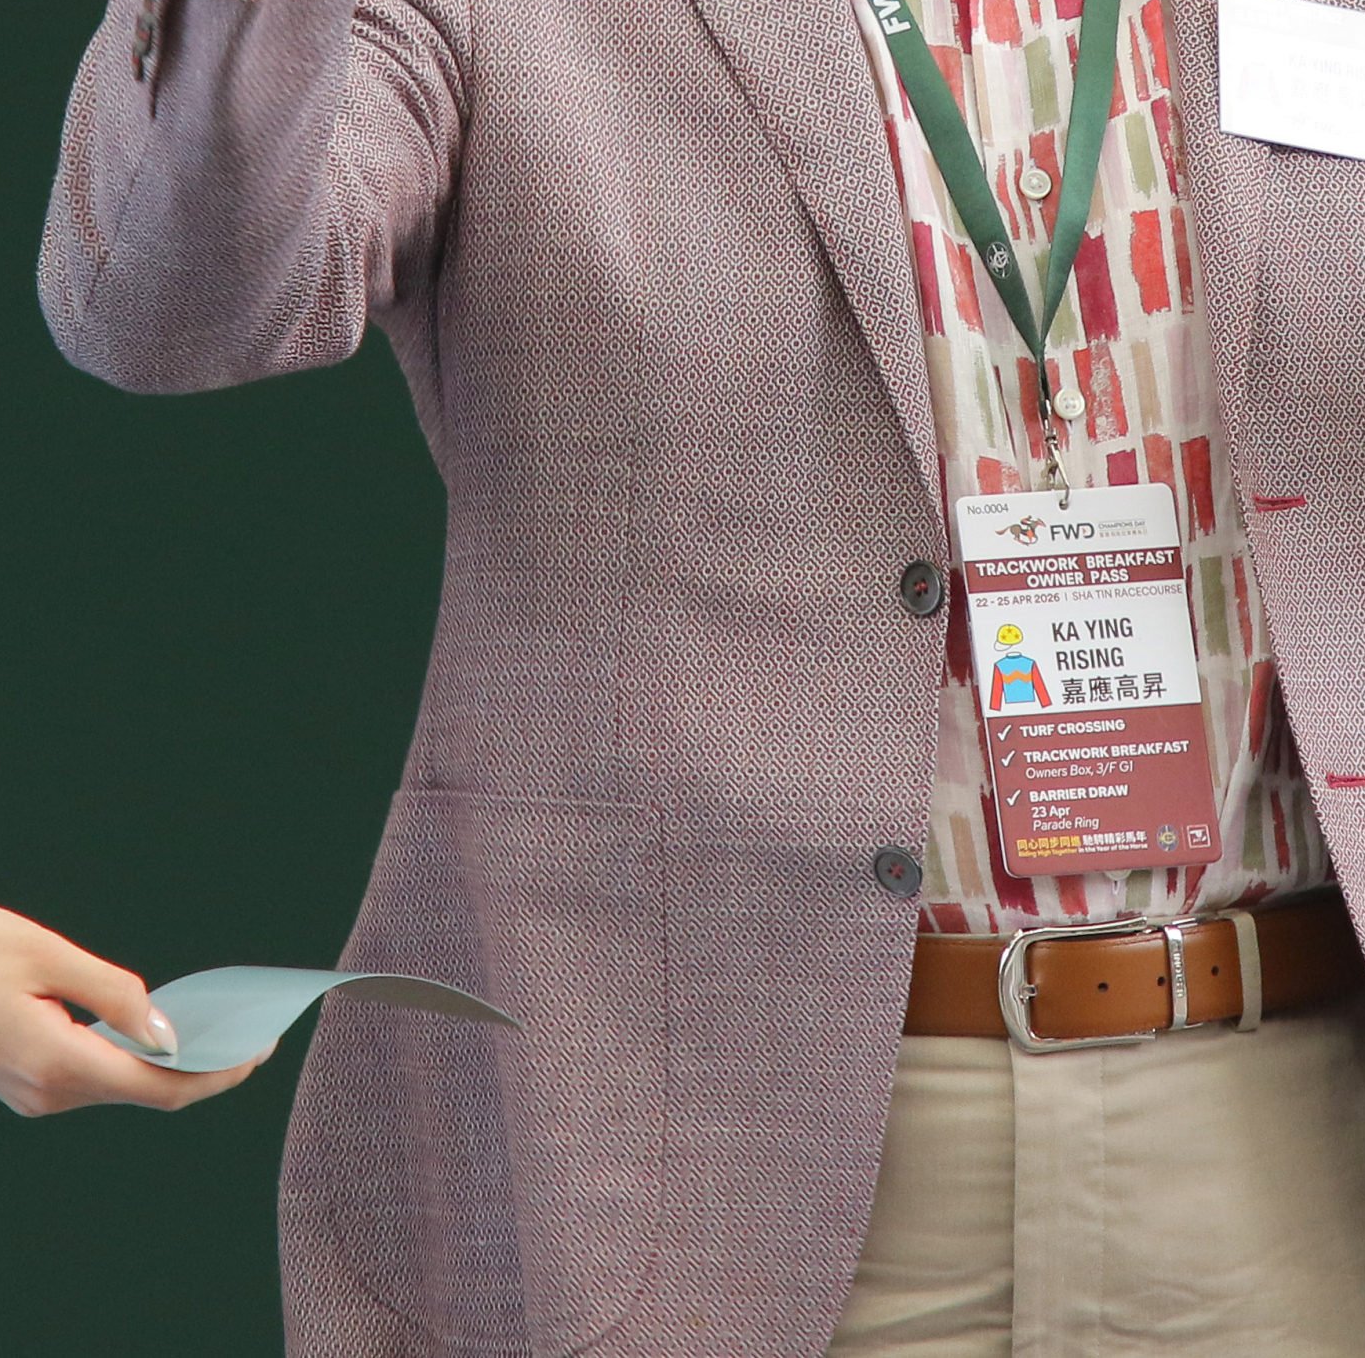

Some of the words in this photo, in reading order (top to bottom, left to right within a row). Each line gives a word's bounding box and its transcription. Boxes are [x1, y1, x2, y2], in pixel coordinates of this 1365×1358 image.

[967, 503, 1009, 515] No.0004
[1050, 523, 1095, 541] FWD
[975, 557, 1079, 576] TRACKWORK
[1085, 549, 1175, 569] BREAKFAST
[1026, 571, 1085, 588] OWNER
[1090, 568, 1129, 583] PASS
[976, 597, 989, 608] 22
[997, 596, 1010, 606] 25
[1012, 594, 1033, 605] APR
[1034, 592, 1060, 604] 2026
[1072, 590, 1094, 602] SHA
[1096, 588, 1113, 599] TIN
[1114, 584, 1183, 598] RACECOURSE
[1051, 621, 1081, 643] KA
[1084, 617, 1134, 640] YING
[1055, 647, 1125, 671] RISING
[1061, 672, 1168, 705] 嘉應高昇
[1019, 723, 1055, 738] TURF
[1057, 719, 1126, 735] CROSSING
[1023, 746, 1109, 763] TRACKWORK
[1111, 740, 1190, 757] BREAKFAST
[1025, 766, 1068, 779] Owners
[1069, 763, 1094, 777] Box,
[1096, 761, 1117, 777] 3/F
[1119, 760, 1134, 773] G1
[1029, 787, 1087, 803] BARRIER
[1088, 784, 1129, 798] DRAW
[1032, 807, 1047, 818] 23
[1049, 805, 1070, 819] Apr
[1033, 817, 1072, 831] Parade
[1075, 816, 1100, 830] Ring
